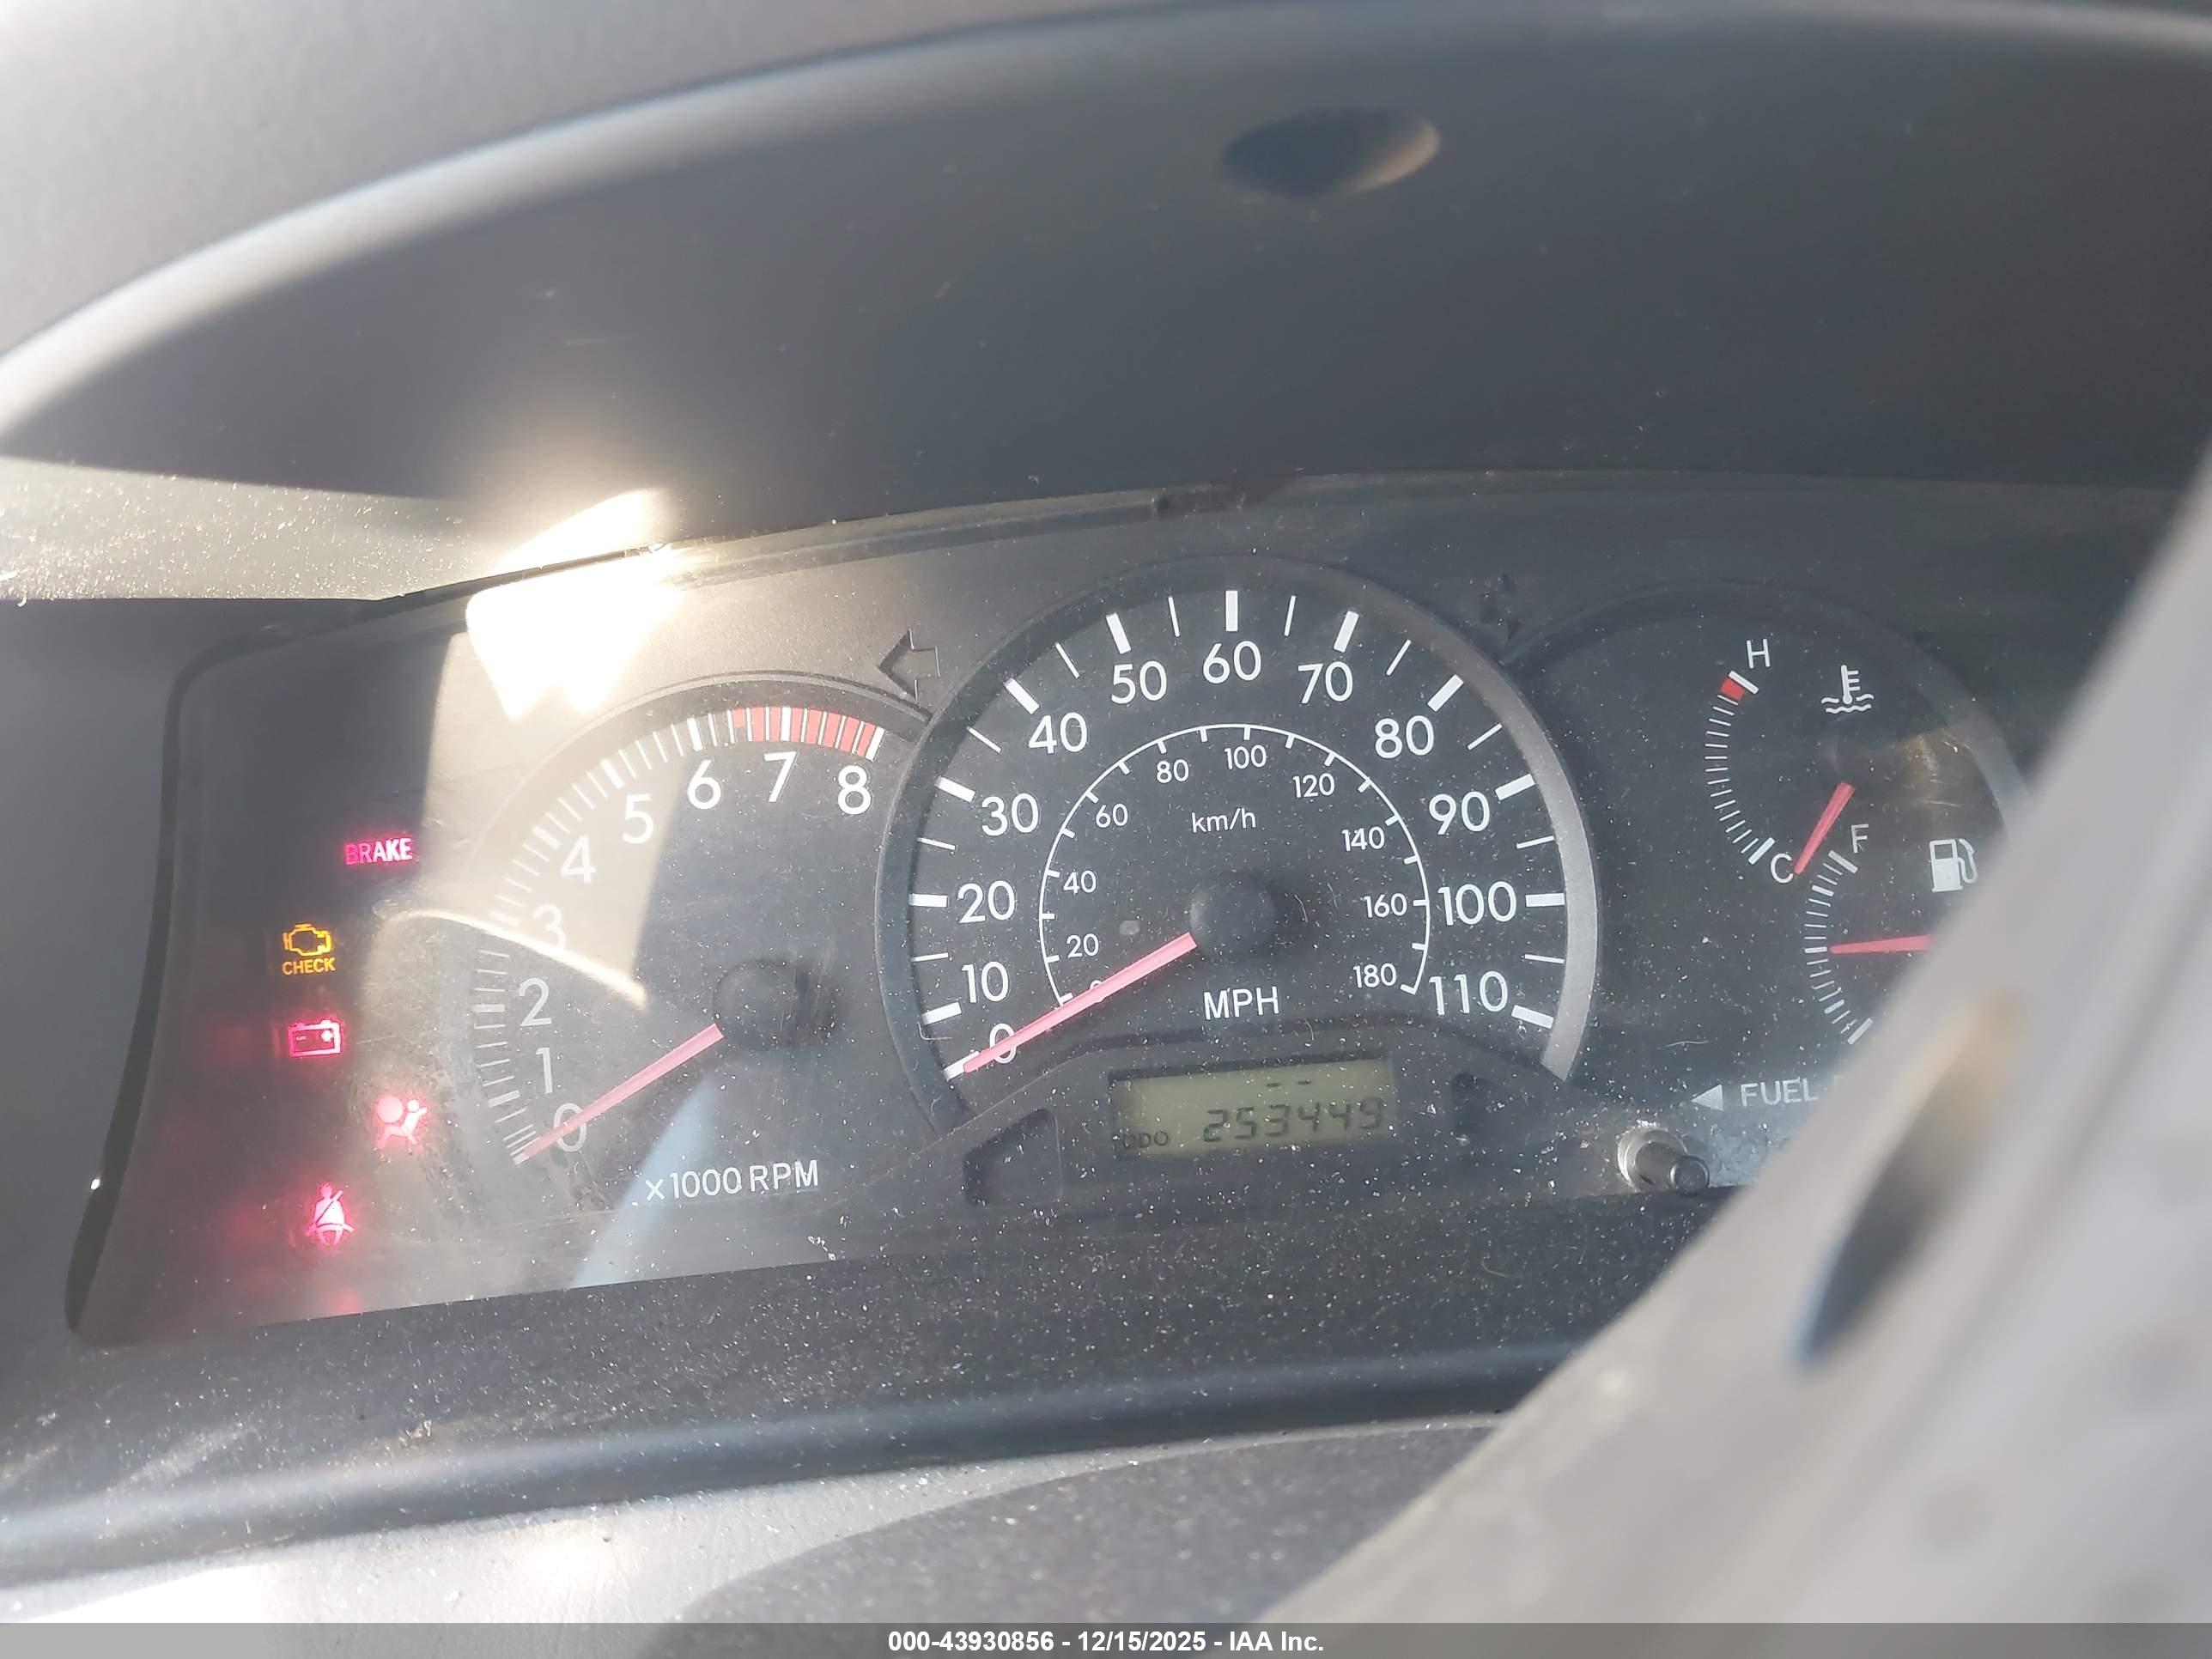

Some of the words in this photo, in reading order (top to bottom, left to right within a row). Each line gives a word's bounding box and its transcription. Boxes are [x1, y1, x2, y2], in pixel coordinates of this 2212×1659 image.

[1202, 640, 1261, 684] 60
[1746, 638, 1771, 668] H
[1111, 660, 1167, 704] 50
[1297, 660, 1353, 704] 70
[1028, 712, 1088, 754] 40
[1374, 714, 1434, 759] 80
[763, 750, 797, 802] 7
[1156, 758, 1189, 784] 80
[1224, 744, 1267, 770] 100
[686, 760, 721, 810] 6
[836, 765, 872, 814] 8
[1292, 772, 1335, 799] 120
[622, 794, 653, 843] 5
[981, 792, 1040, 836] 30
[1095, 803, 1128, 828] 60
[1191, 806, 1257, 834] km/h
[1429, 791, 1491, 836] 90
[345, 837, 413, 865] BRAKE
[560, 835, 597, 883] 4
[1341, 826, 1385, 852] 140
[1850, 823, 1870, 854] F
[1063, 870, 1097, 895] 40
[1769, 851, 1795, 884] C
[957, 880, 1017, 924] 20
[1364, 892, 1407, 919] 160
[1437, 881, 1517, 926] 100
[532, 904, 567, 949] 3
[1066, 933, 1099, 958] 20
[282, 957, 336, 975] CHECK
[961, 961, 1009, 1004] 10
[1352, 962, 1397, 988] 180
[518, 977, 552, 1026] 2
[1203, 985, 1279, 1020] MPH
[1428, 970, 1509, 1016] 110
[988, 1023, 1018, 1064] 0
[535, 1047, 553, 1094] 1
[1740, 1076, 1819, 1108] FUEL
[553, 1103, 587, 1152] 0
[1203, 1097, 1383, 1142] 253449
[749, 1158, 819, 1193] RPM
